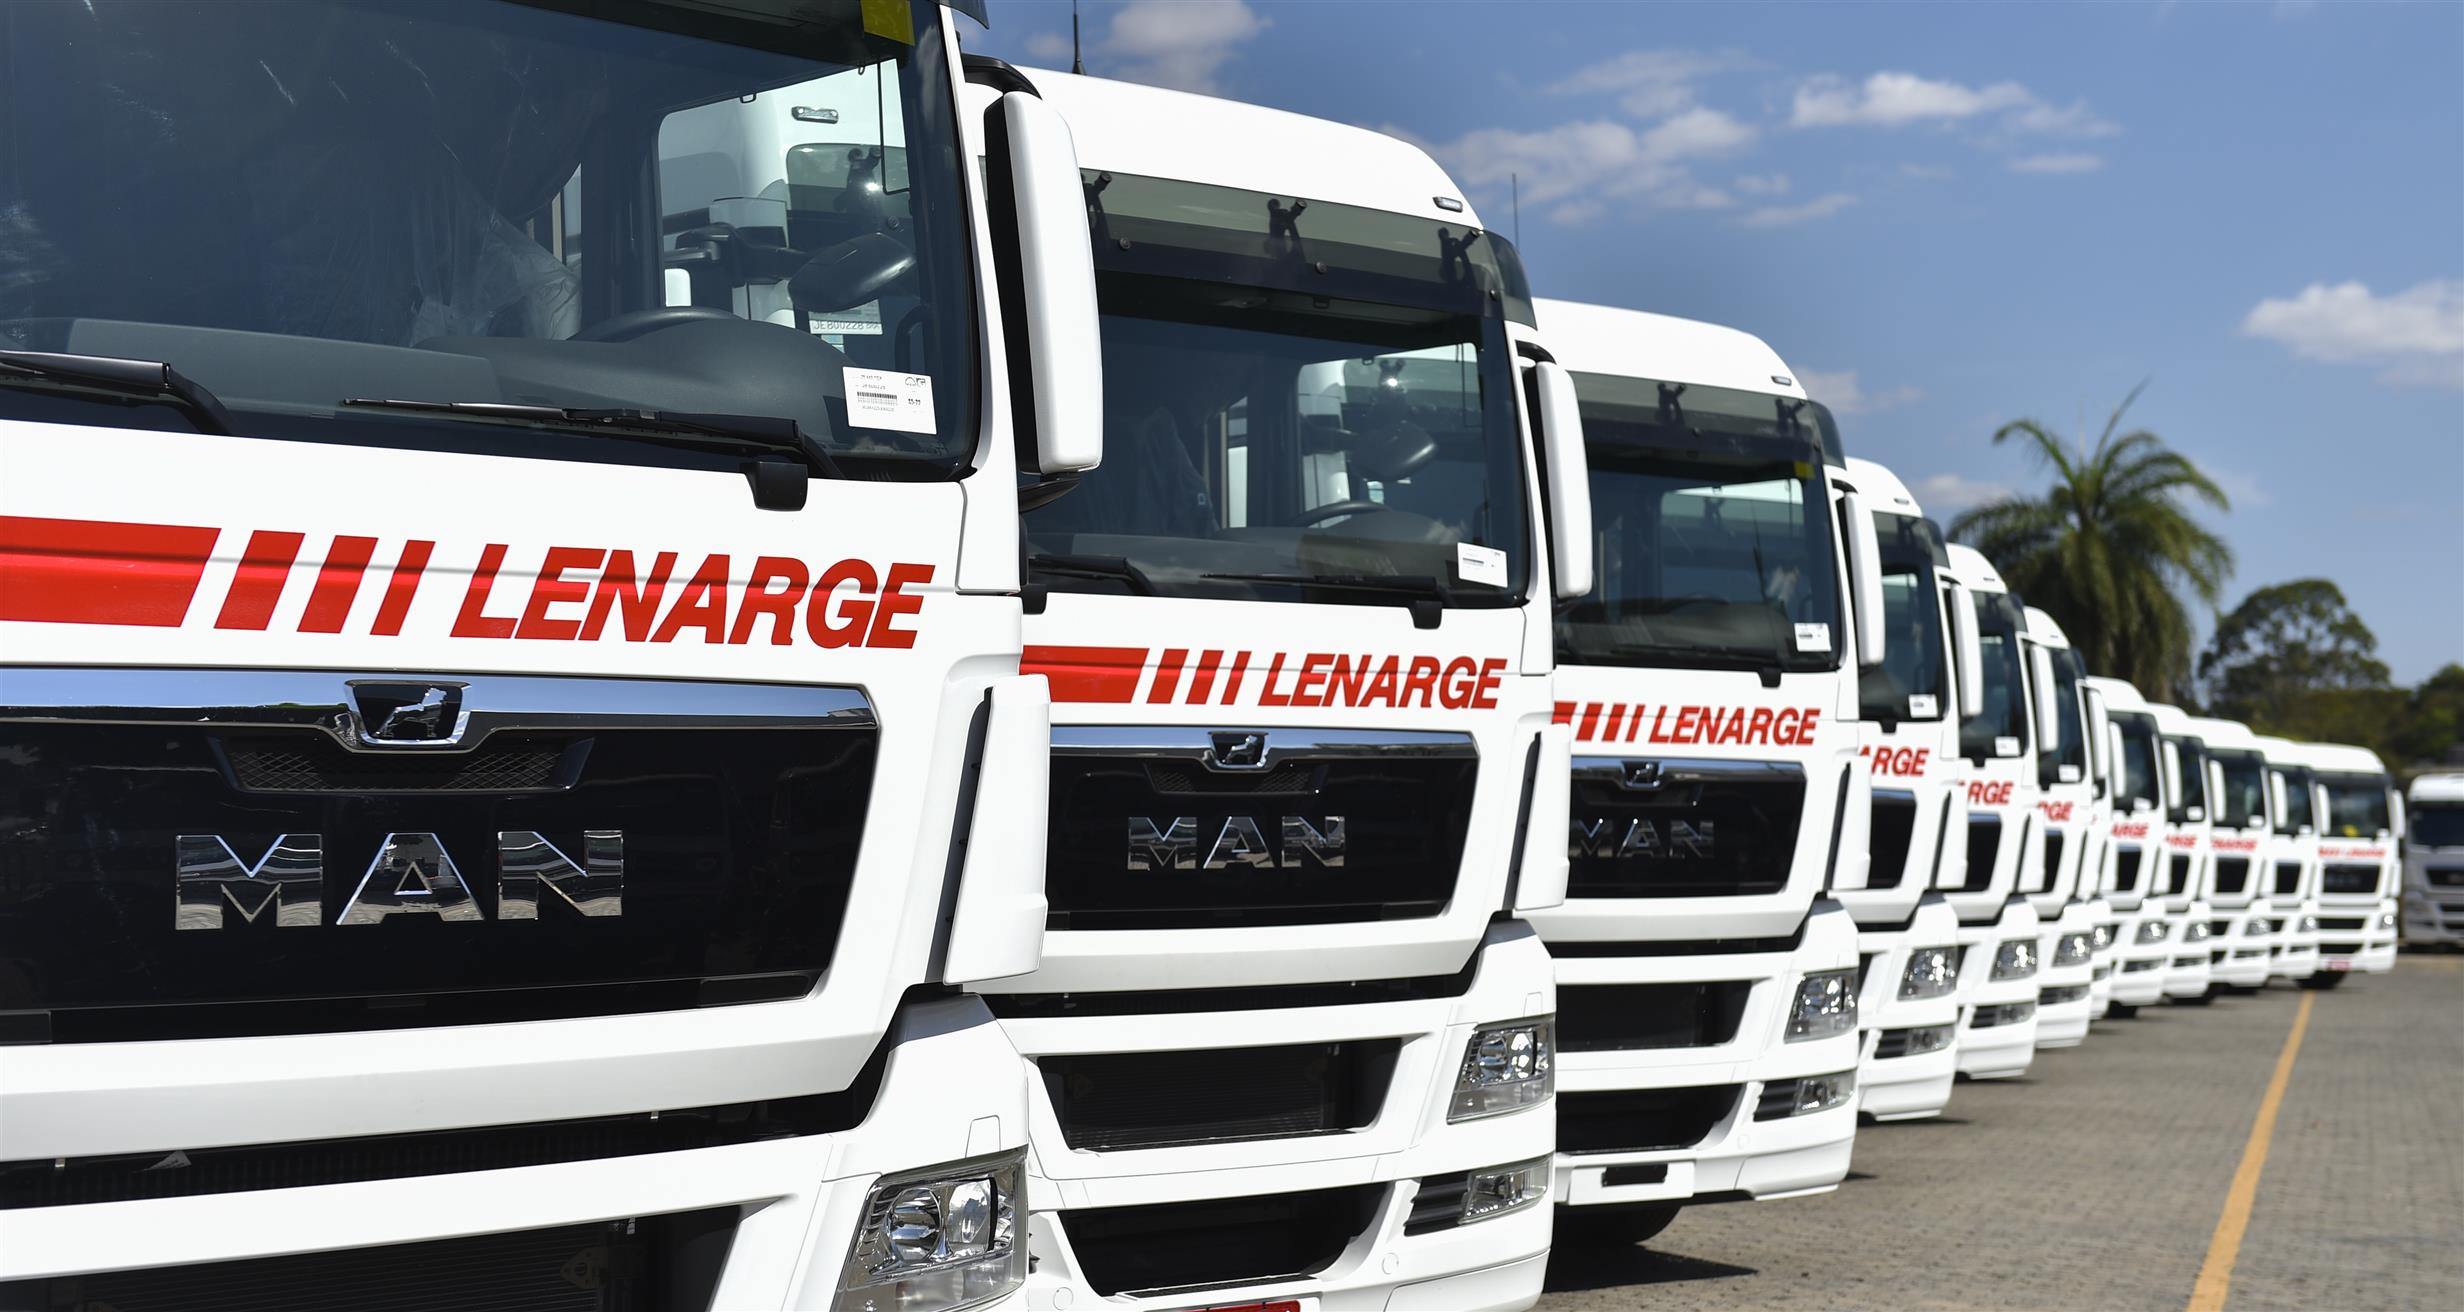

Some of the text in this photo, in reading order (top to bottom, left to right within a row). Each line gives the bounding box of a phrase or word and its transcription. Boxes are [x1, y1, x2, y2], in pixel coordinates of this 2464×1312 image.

[449, 543, 936, 650] LENARGE
[1258, 651, 1508, 710] LENARGE
[1648, 704, 1821, 747] LENARGE
[1957, 780, 2014, 806] RGE
[1127, 816, 1345, 871] MAN
[1569, 818, 1715, 858] MAN
[175, 830, 624, 931] MAN
